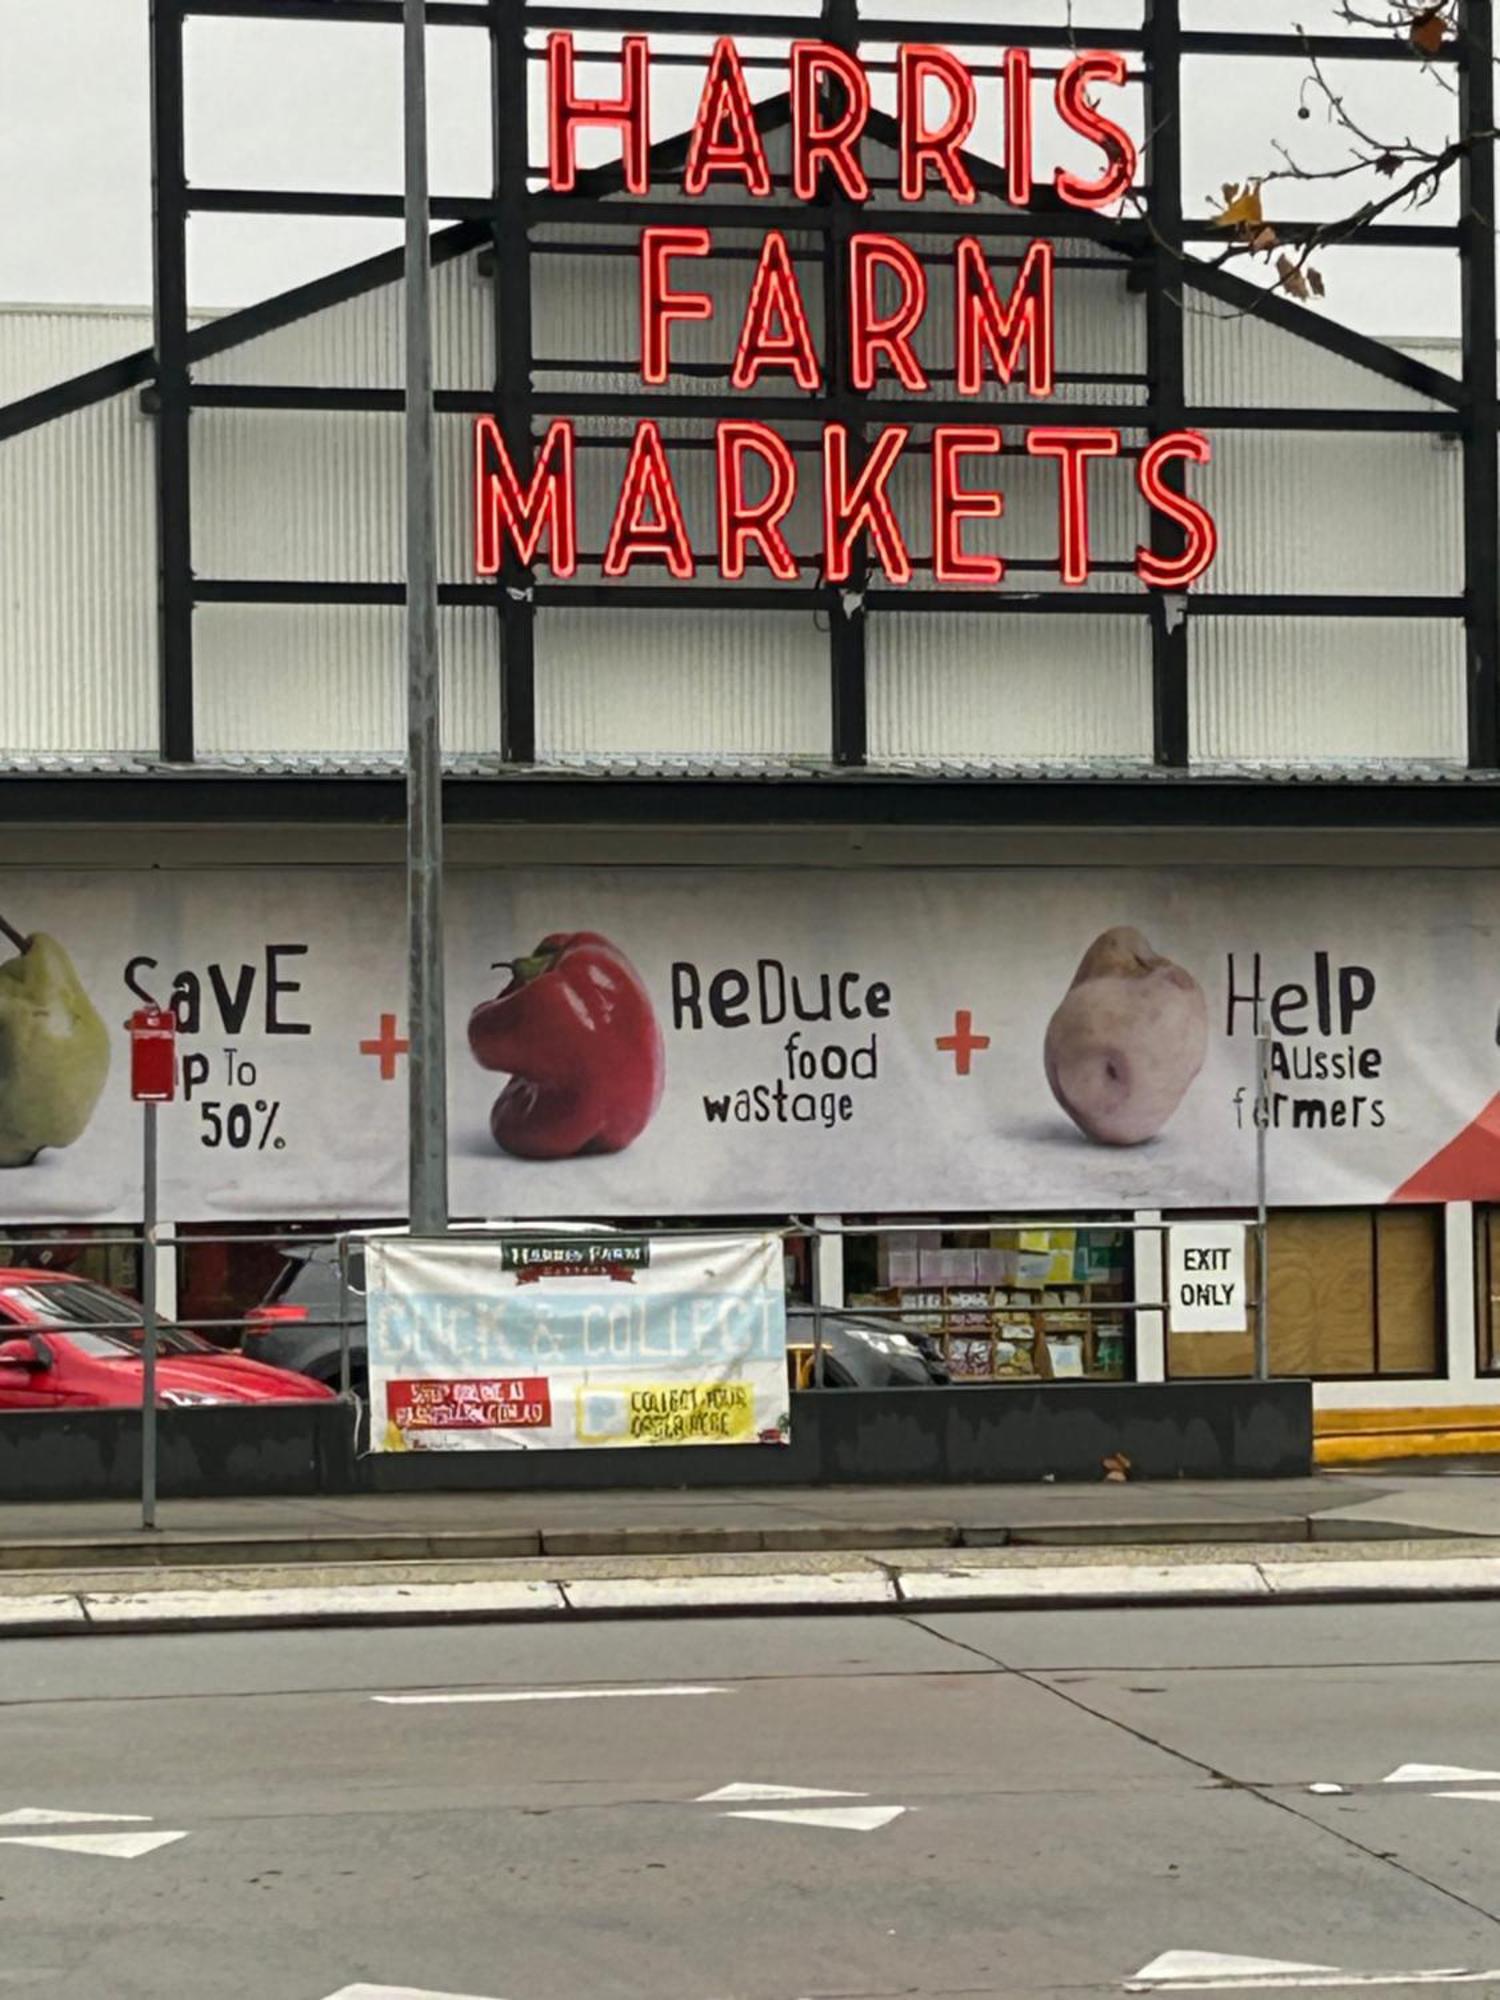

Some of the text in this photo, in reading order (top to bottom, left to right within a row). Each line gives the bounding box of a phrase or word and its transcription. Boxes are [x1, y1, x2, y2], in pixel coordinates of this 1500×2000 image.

[545, 32, 1137, 209] HARRIS
[639, 226, 1054, 397] FARM
[473, 414, 1217, 588] MARKETS
[223, 1048, 256, 1086] To
[784, 1031, 877, 1080] food
[1264, 1041, 1382, 1080] Aussie
[201, 1100, 286, 1150] 50%
[703, 1079, 853, 1128] wastage
[1184, 1248, 1231, 1270] EXIT
[1180, 1283, 1235, 1306] ONLY
